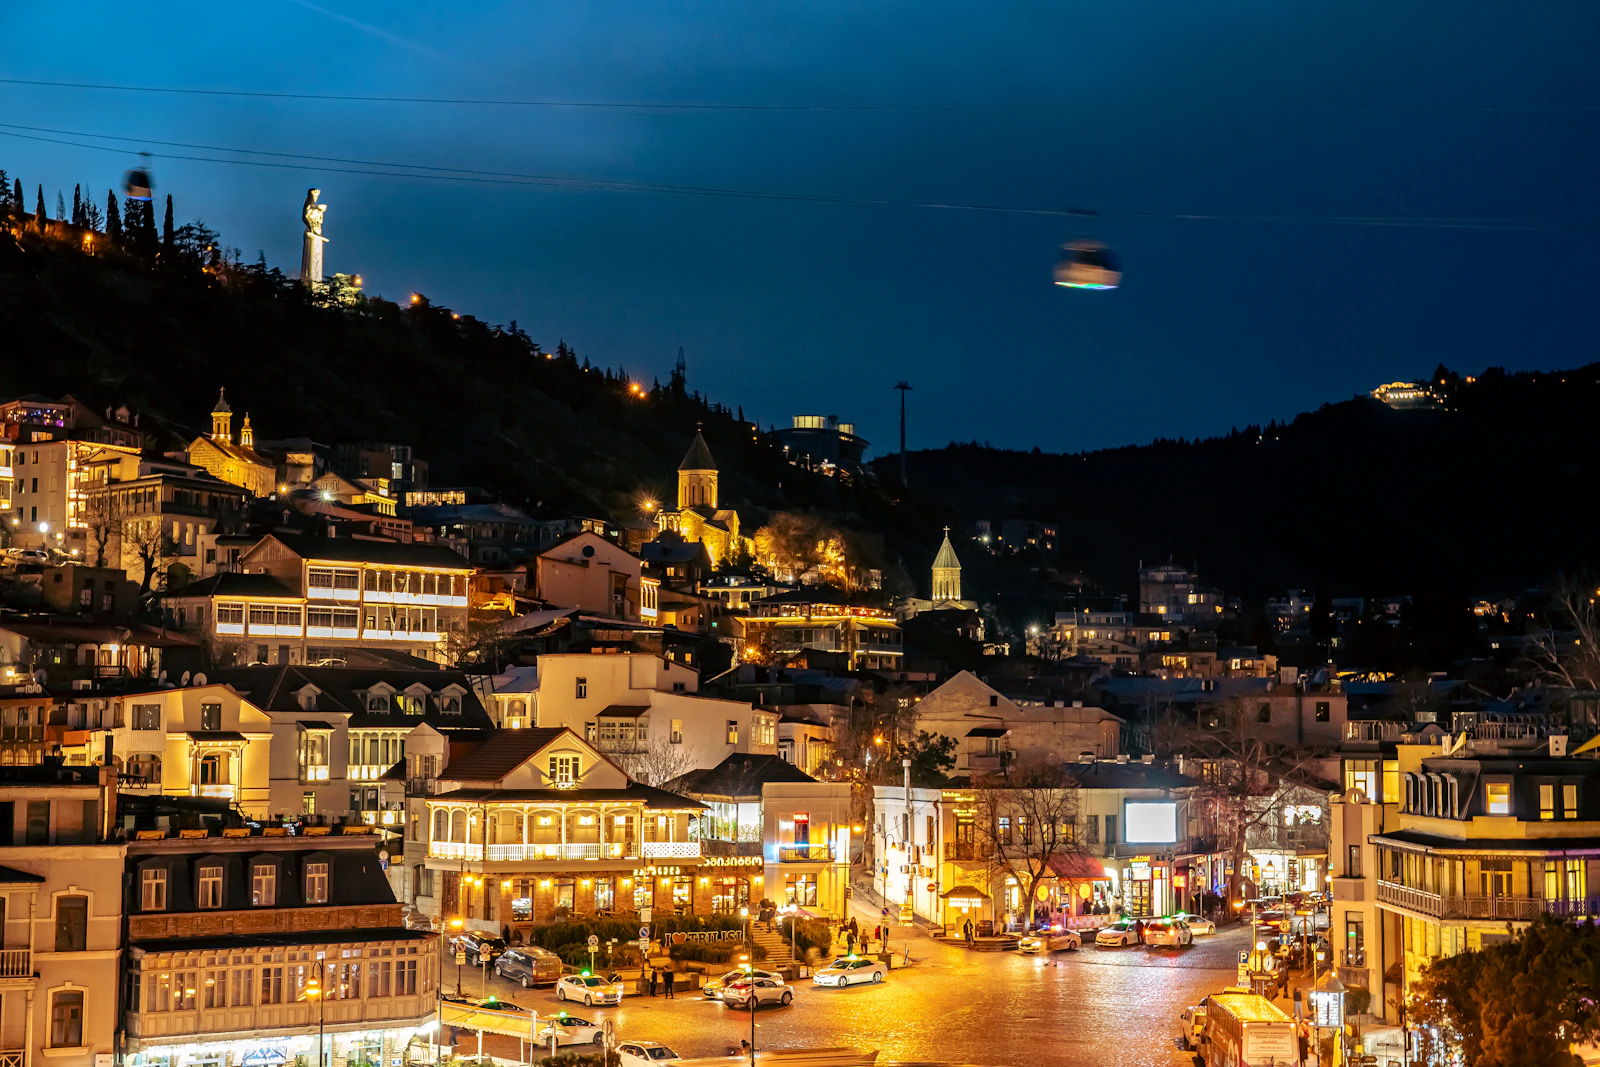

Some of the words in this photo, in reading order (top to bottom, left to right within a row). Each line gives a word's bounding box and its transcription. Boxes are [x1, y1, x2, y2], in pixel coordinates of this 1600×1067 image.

[697, 857, 763, 867] ამიკიტნო
[665, 933, 671, 947] I
[688, 930, 742, 943] TBILISI
